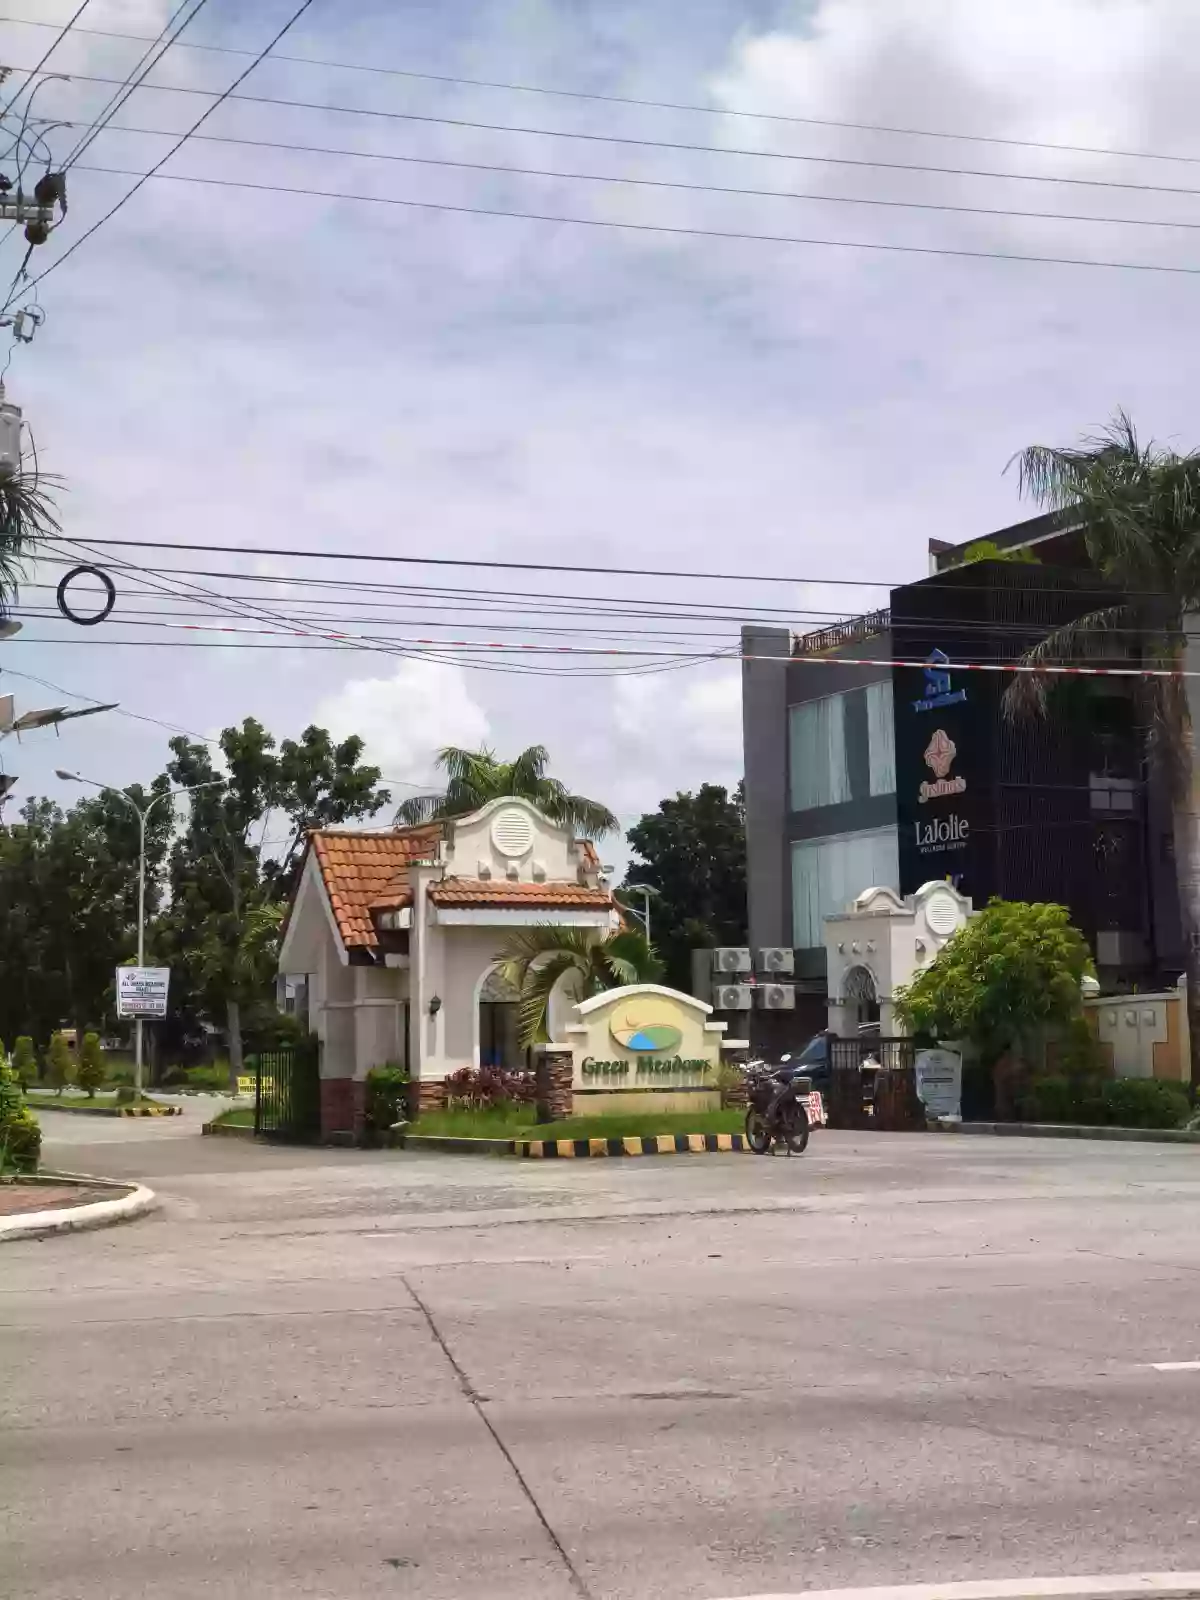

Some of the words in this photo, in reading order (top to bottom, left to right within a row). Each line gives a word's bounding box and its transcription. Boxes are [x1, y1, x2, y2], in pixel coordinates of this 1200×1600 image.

[915, 813, 969, 845] LaJolie
[581, 1056, 629, 1074] Green
[635, 1055, 713, 1075] Meadows
